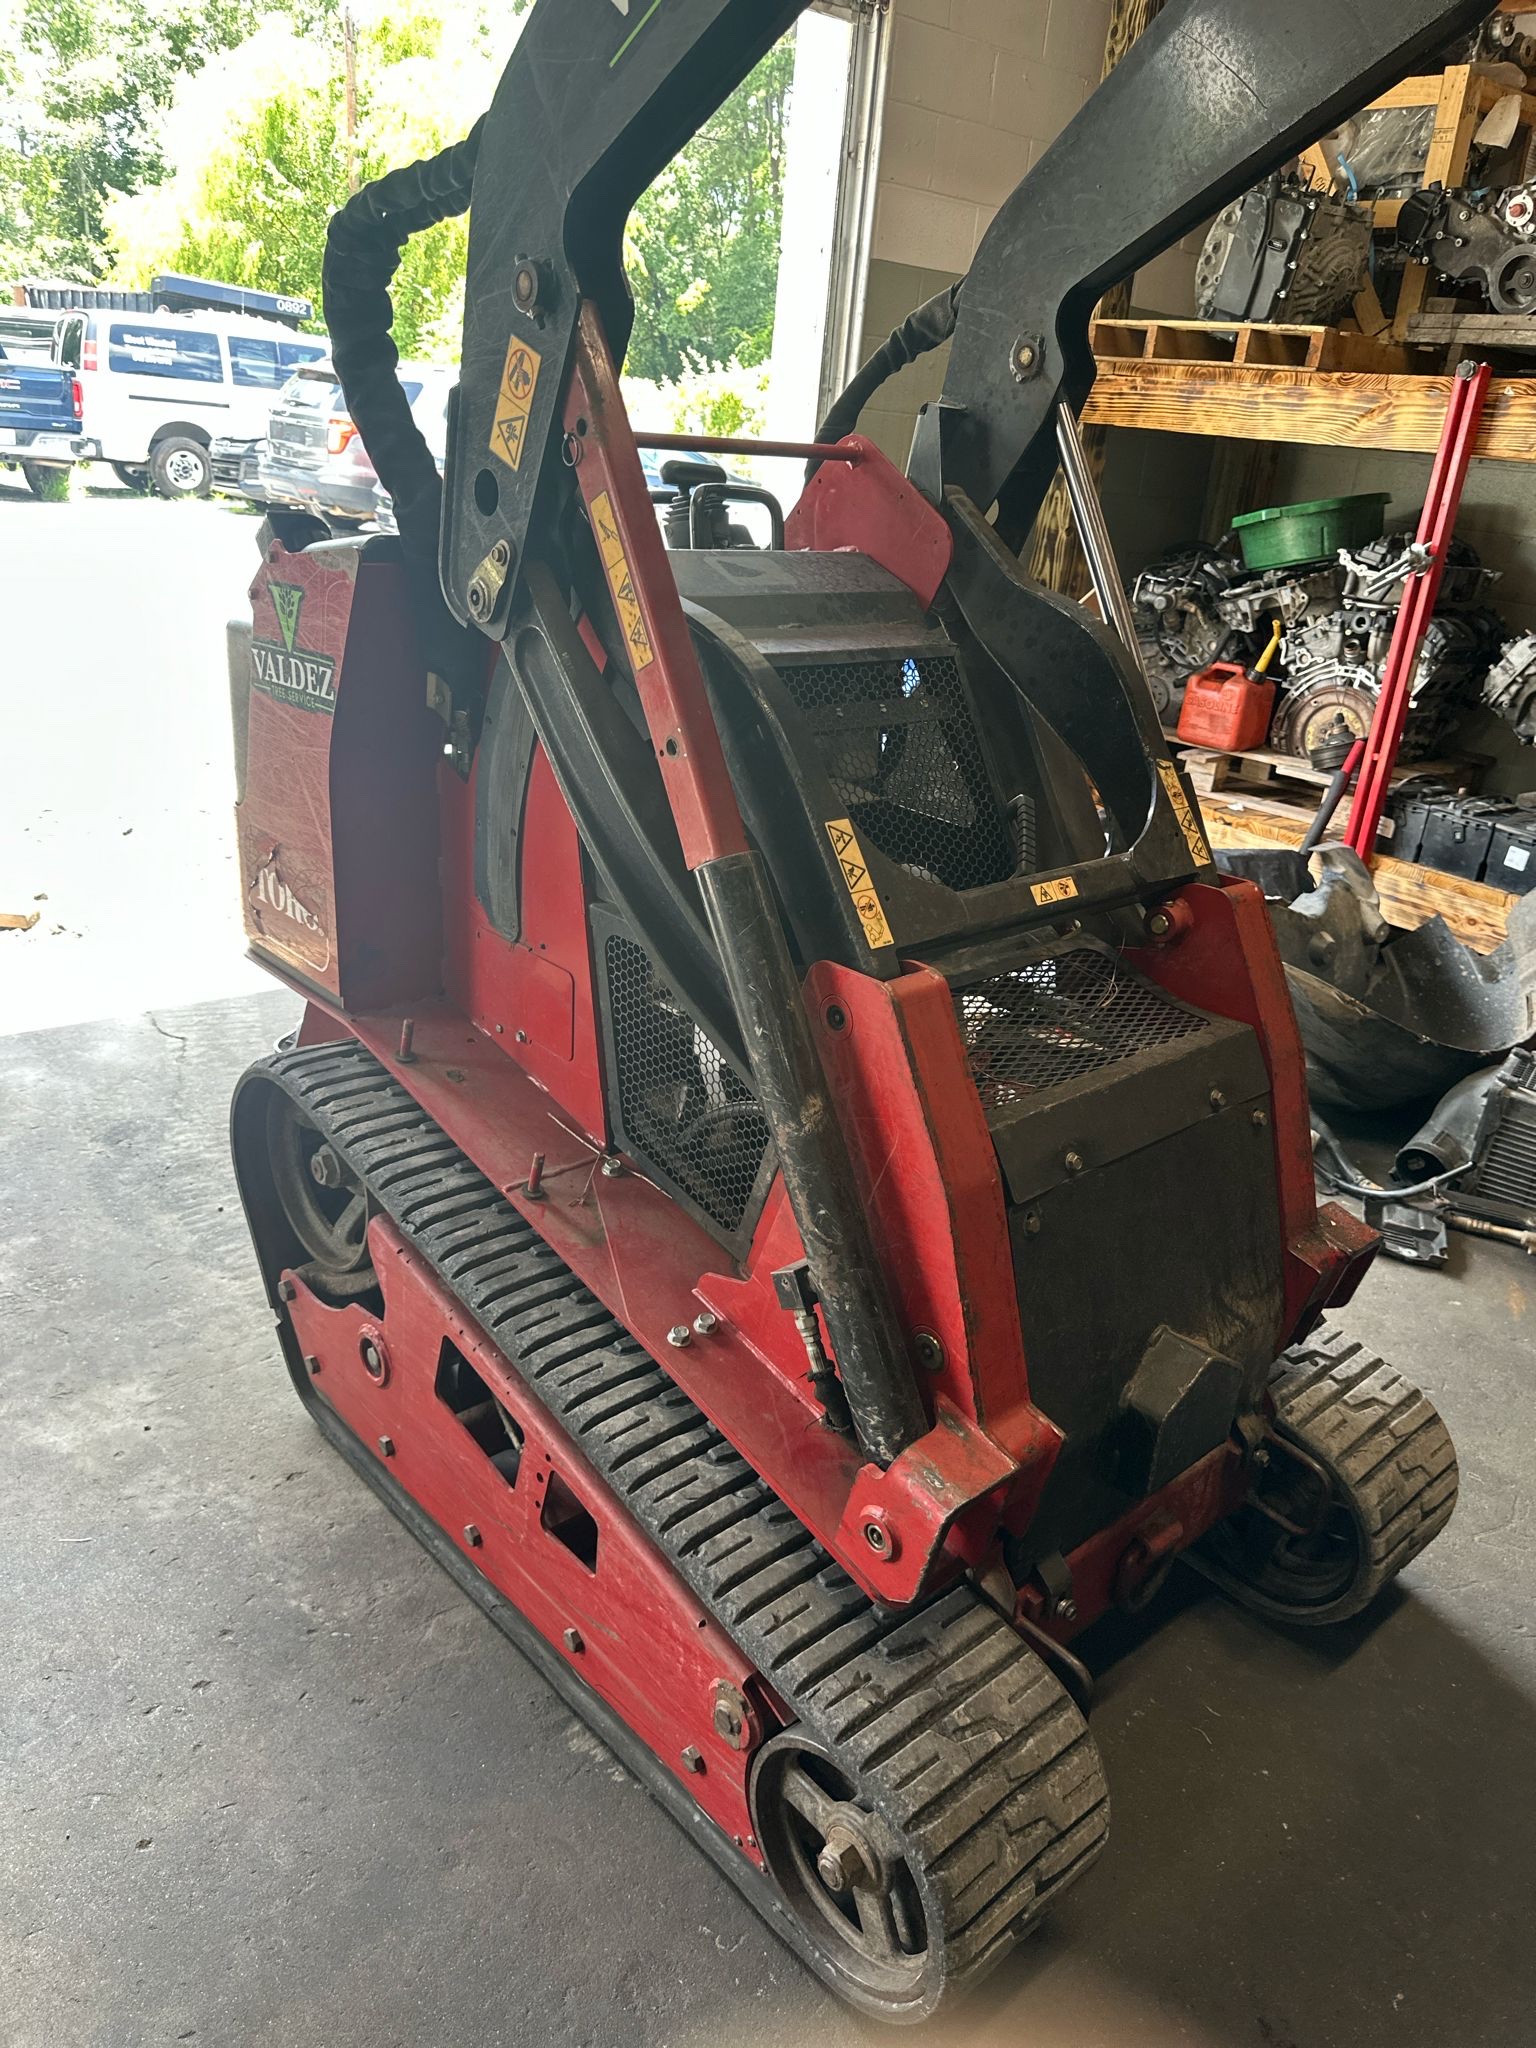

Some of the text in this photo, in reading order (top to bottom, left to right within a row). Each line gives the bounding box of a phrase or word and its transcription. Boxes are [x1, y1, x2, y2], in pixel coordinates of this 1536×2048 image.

[276, 299, 307, 315] 0892
[251, 648, 334, 701] VALDEZ
[271, 685, 315, 708] TREE SERVICE
[1185, 696, 1240, 715] GASOLINE
